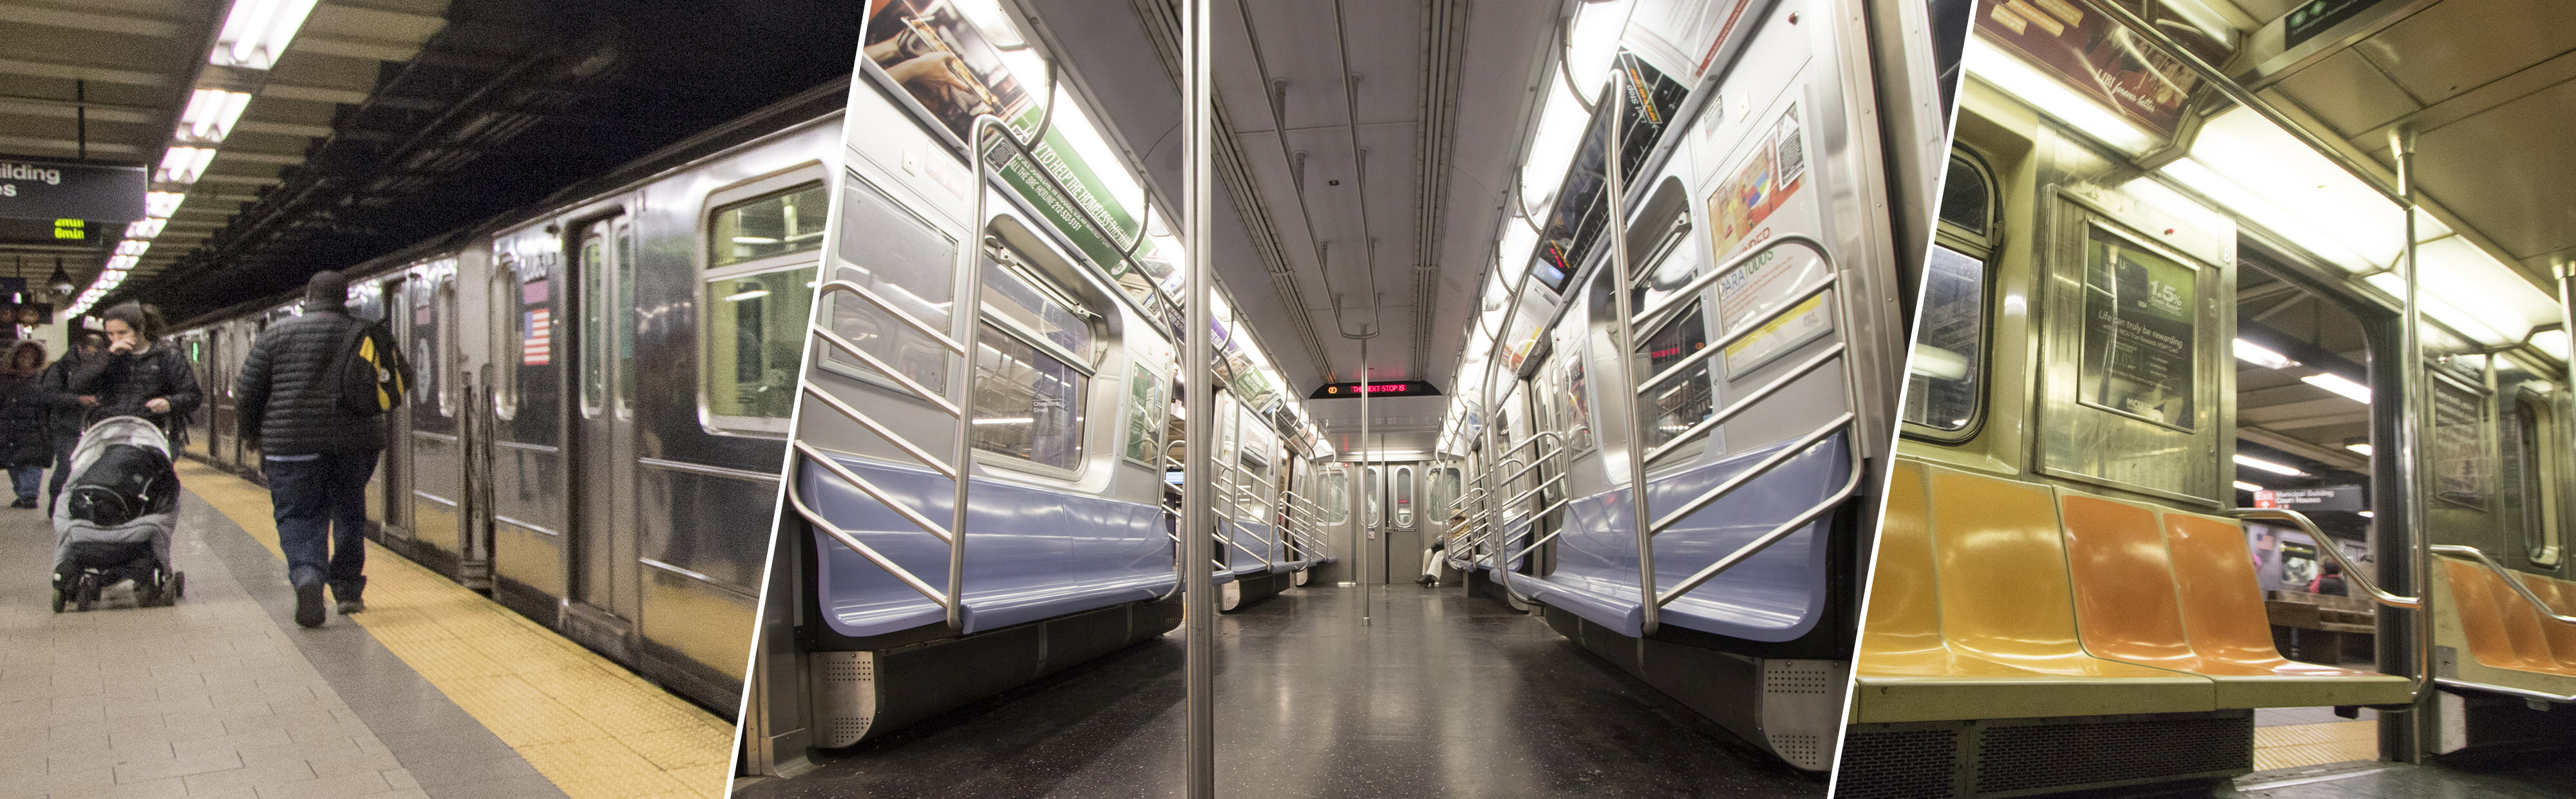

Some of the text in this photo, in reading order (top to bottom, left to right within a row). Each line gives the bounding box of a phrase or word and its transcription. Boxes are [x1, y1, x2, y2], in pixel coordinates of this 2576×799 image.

[1627, 84, 1640, 105] Stop
[0, 162, 61, 185] ilding
[0, 184, 17, 197] s
[1008, 159, 1082, 231] ALL THE BRC HOTLINE 212-533-5151
[1039, 148, 1056, 166] TO
[1048, 158, 1072, 184] HELP
[1065, 177, 1083, 197] THE
[1077, 189, 1112, 227] HOMELESS
[1106, 220, 1123, 238] THIS
[2150, 280, 2182, 307] 1.5%
[2099, 310, 2112, 322] Life
[2127, 320, 2142, 334] truly
[2143, 325, 2152, 336] be
[2152, 329, 2184, 349] rewarding
[2255, 492, 2274, 500] Exit
[2307, 490, 2334, 498] Building
